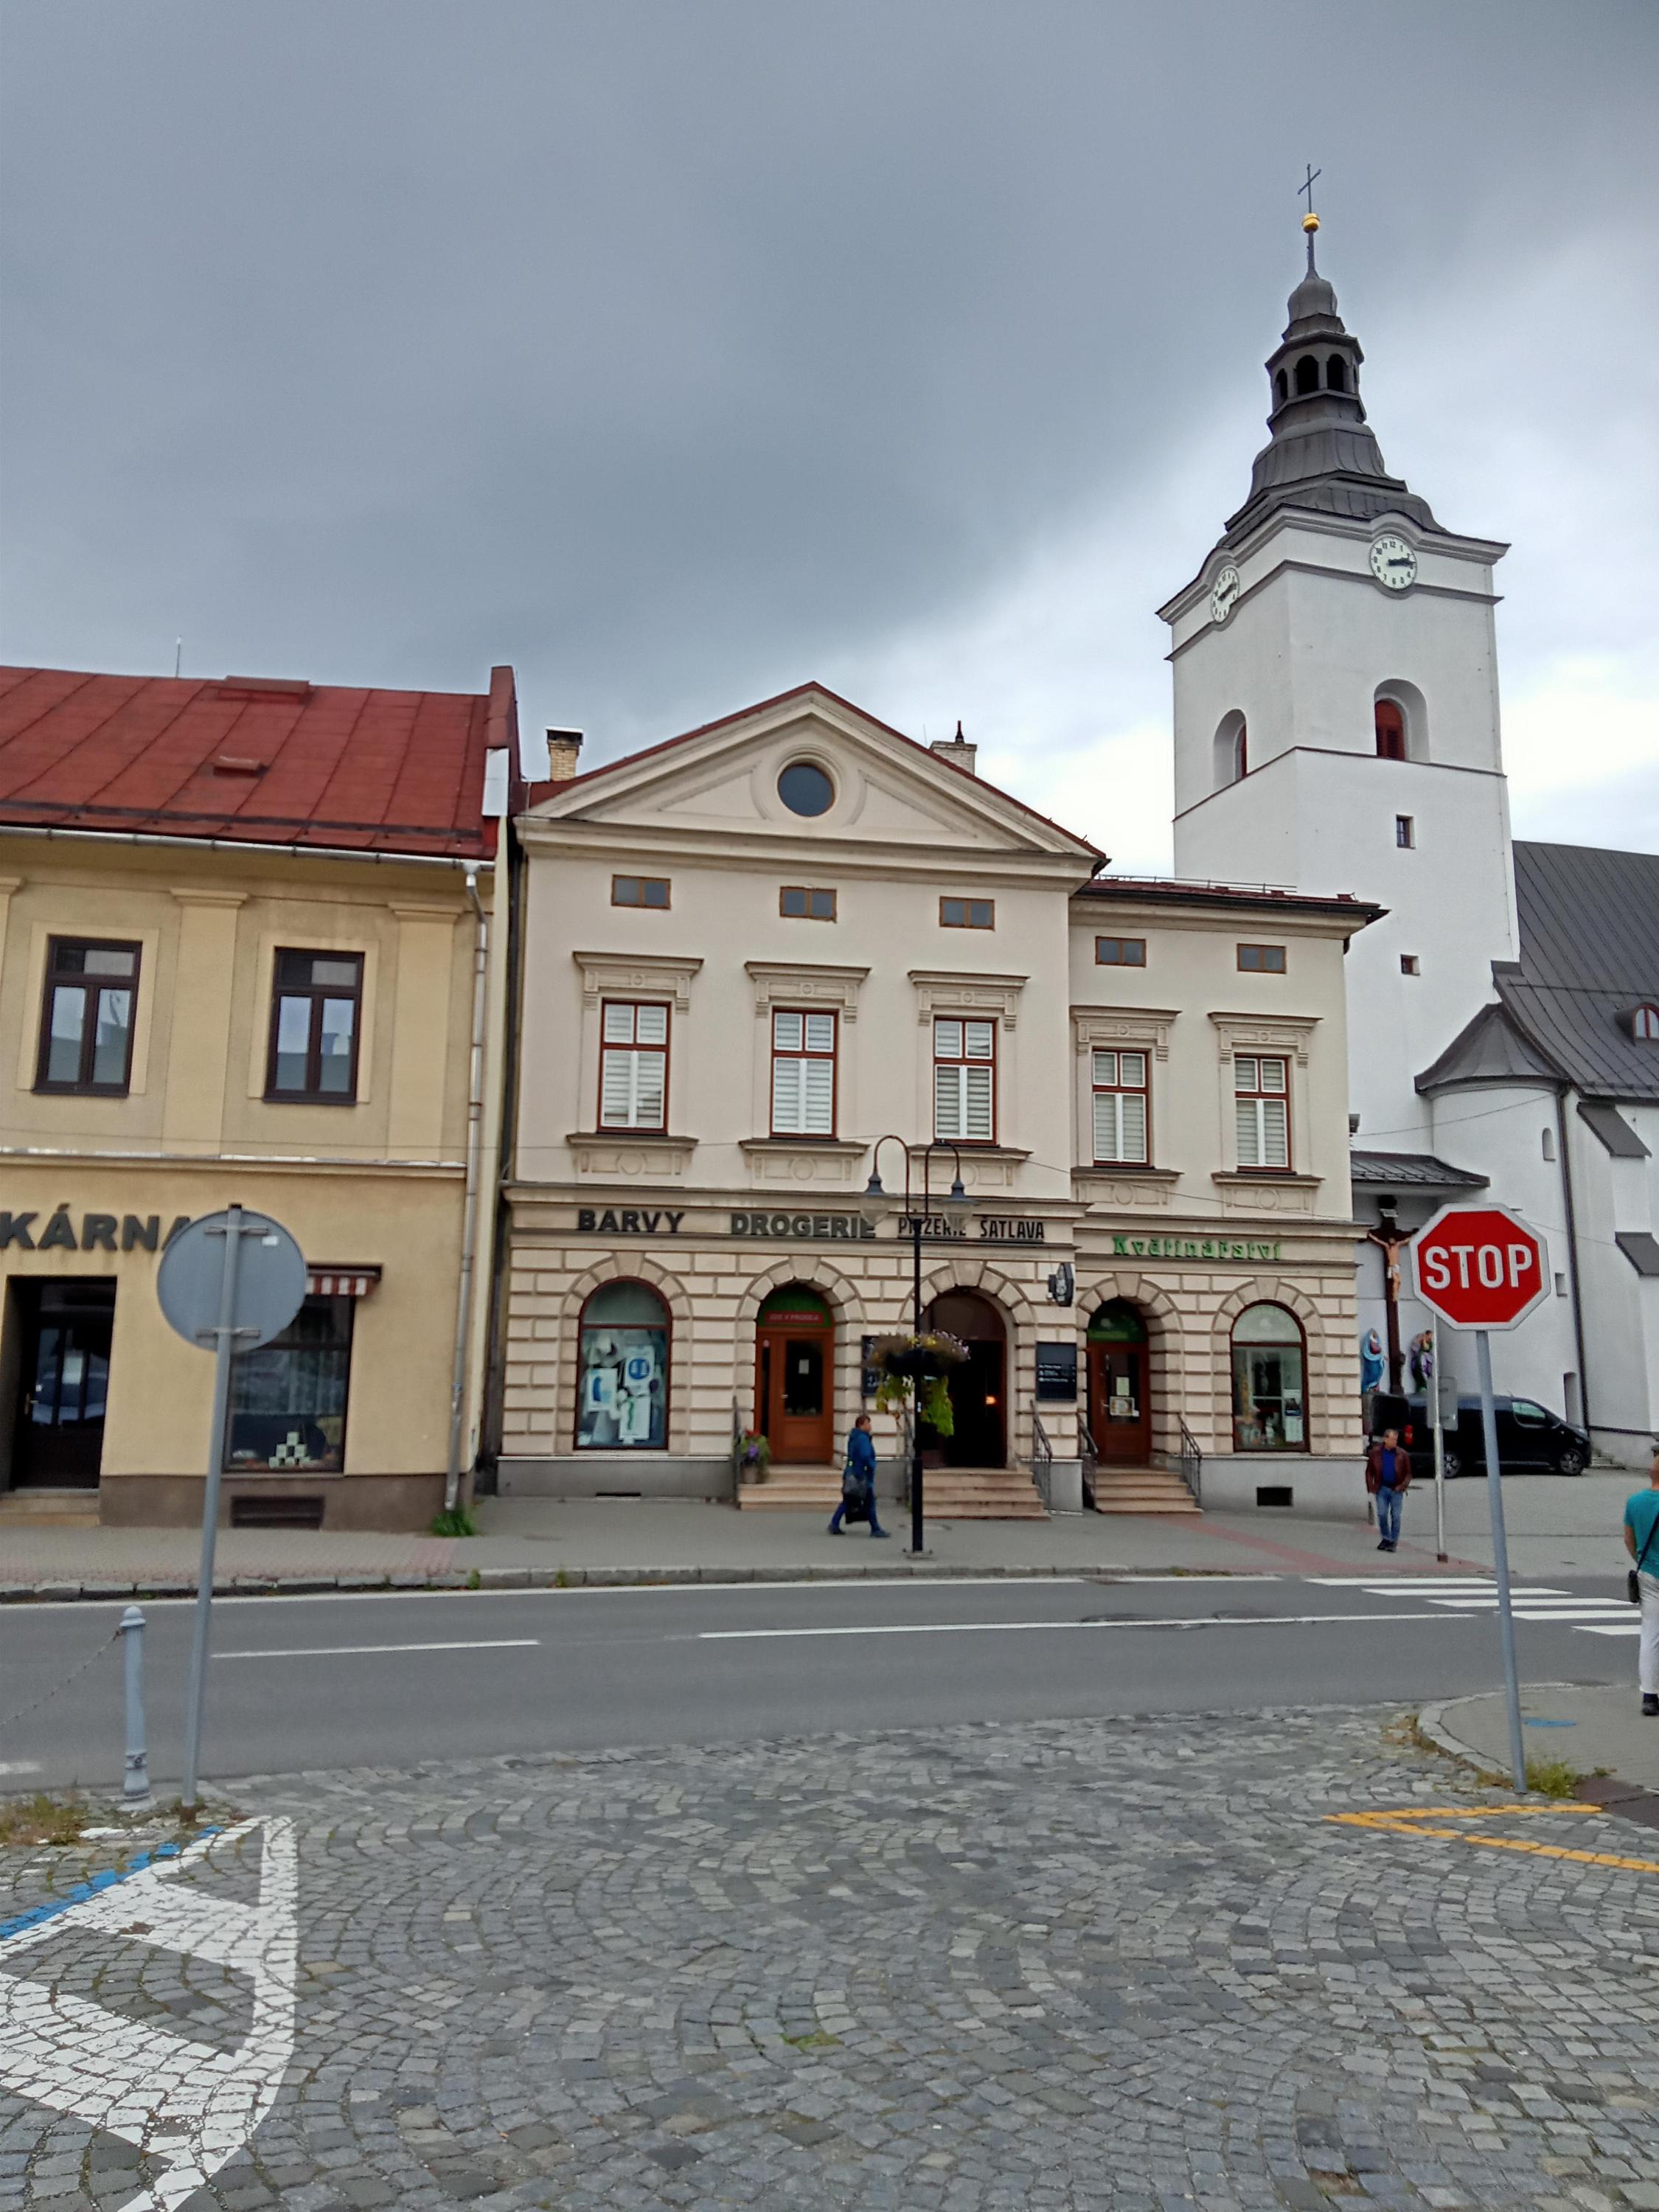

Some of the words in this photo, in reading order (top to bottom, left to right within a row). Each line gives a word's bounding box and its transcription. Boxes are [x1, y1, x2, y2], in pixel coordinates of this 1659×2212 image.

[577, 1209, 685, 1233] BARVY
[730, 1213, 876, 1239] DROGERIE
[980, 1216, 1045, 1239] ŠATLAVA
[1424, 1243, 1533, 1290] STOP
